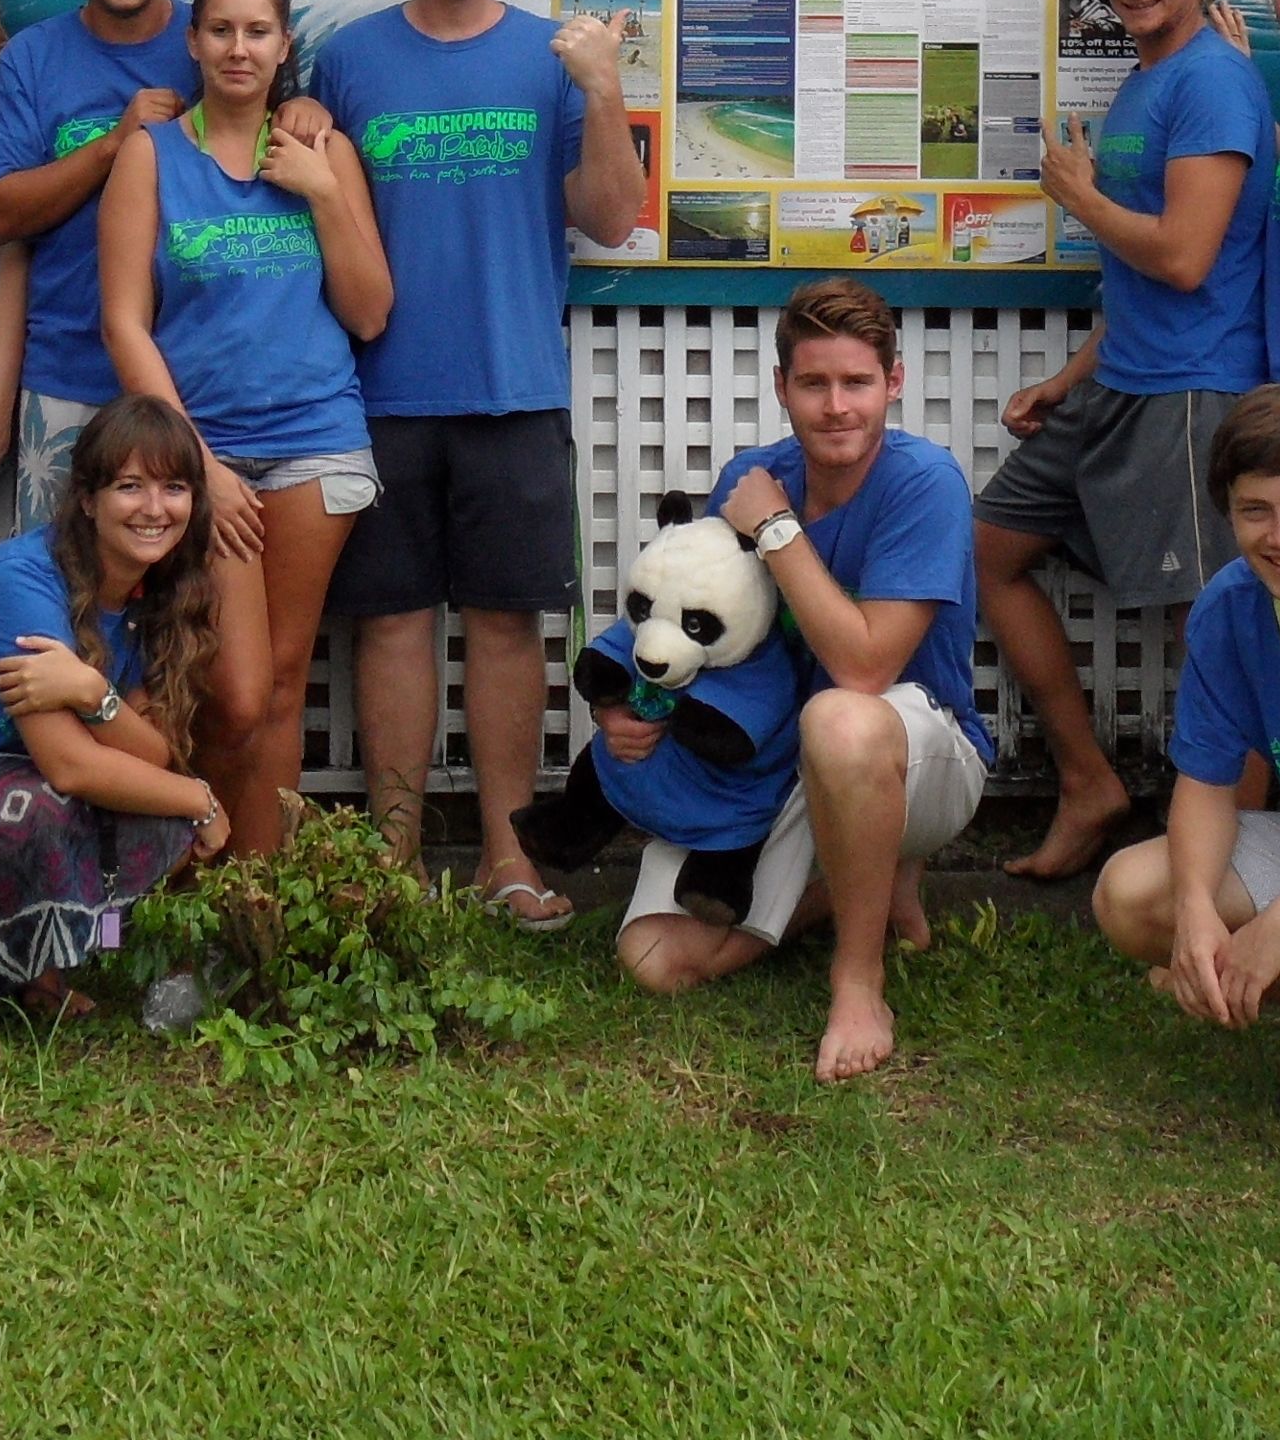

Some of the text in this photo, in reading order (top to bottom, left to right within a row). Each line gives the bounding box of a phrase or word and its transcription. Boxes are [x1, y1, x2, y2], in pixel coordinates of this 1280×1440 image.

[1060, 39, 1084, 48] 10%
[1086, 38, 1103, 48] off
[1104, 39, 1121, 48] RSA
[1058, 99, 1109, 109] www.hia
[414, 111, 538, 136] BACKPACKERS
[406, 131, 529, 163] In Paradise
[436, 164, 466, 185] party
[223, 212, 314, 235] BACKPACK
[965, 213, 993, 226] OFF!
[251, 229, 320, 257] Parad
